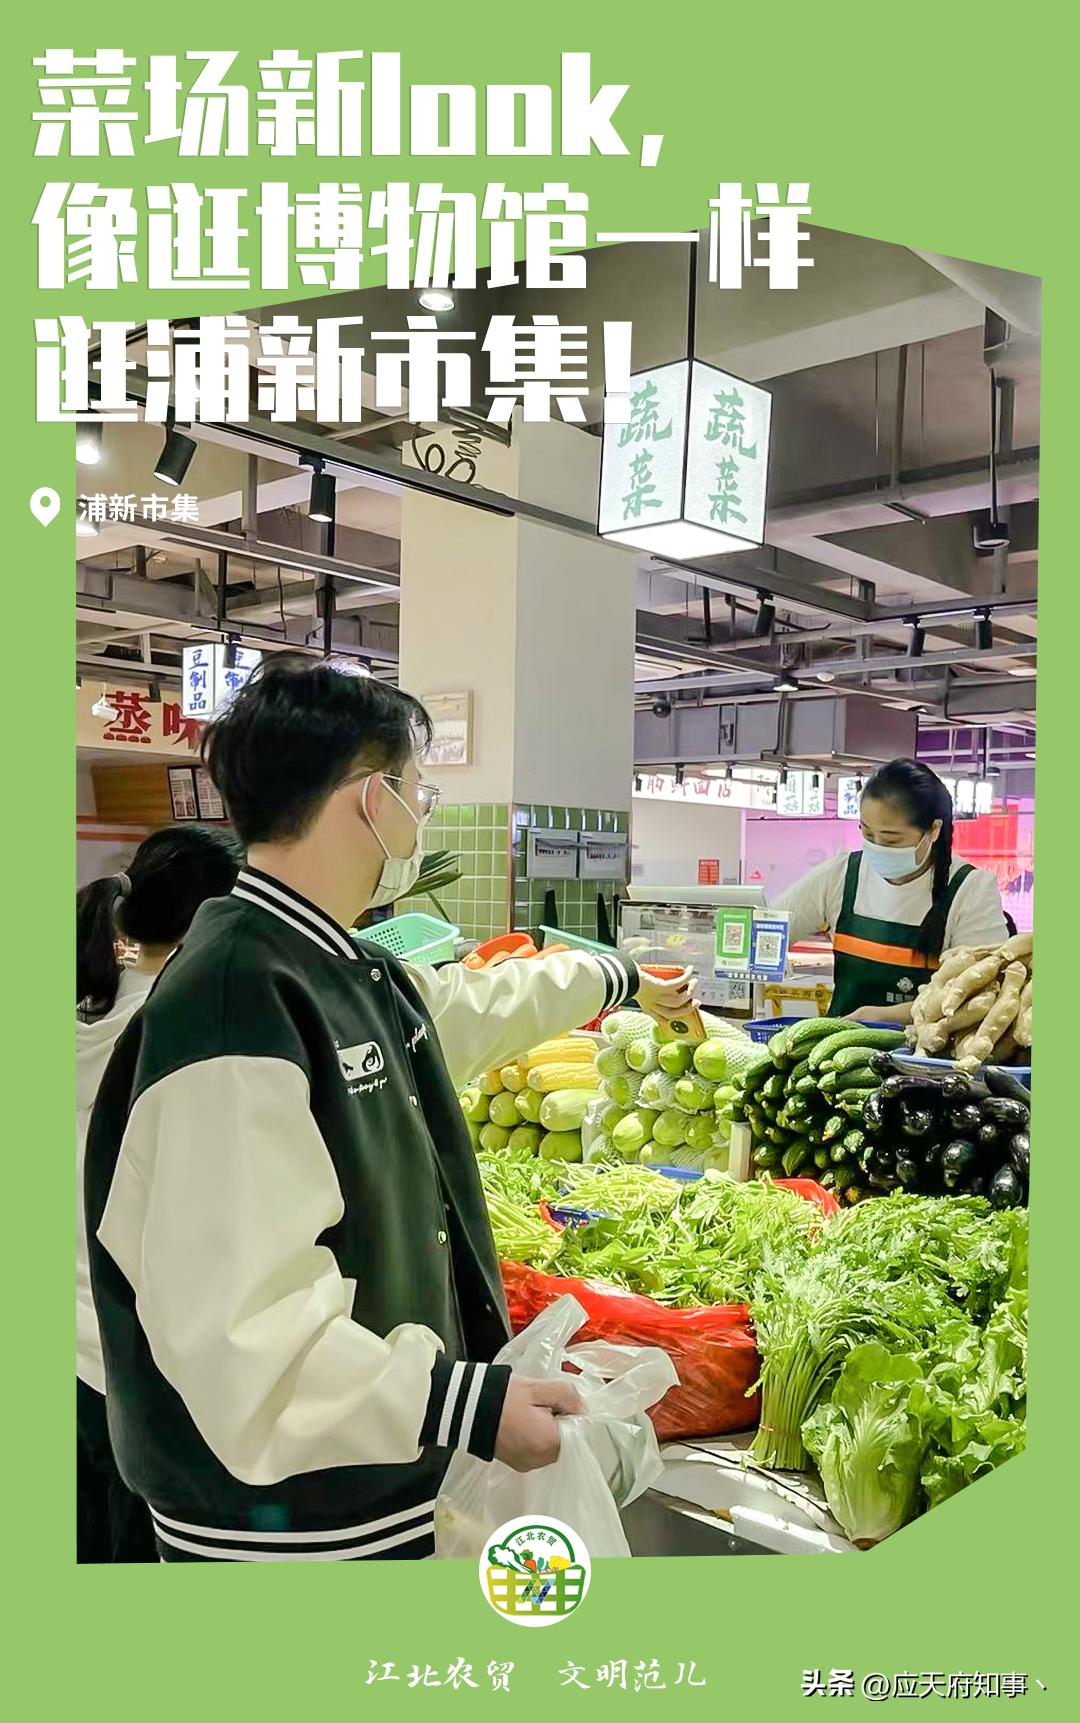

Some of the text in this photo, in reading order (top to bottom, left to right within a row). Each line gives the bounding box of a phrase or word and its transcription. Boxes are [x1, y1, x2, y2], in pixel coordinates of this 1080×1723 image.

[617, 380, 673, 520] 蔬菜
[704, 387, 757, 524] 蔬菜
[188, 649, 209, 710] 豆制品
